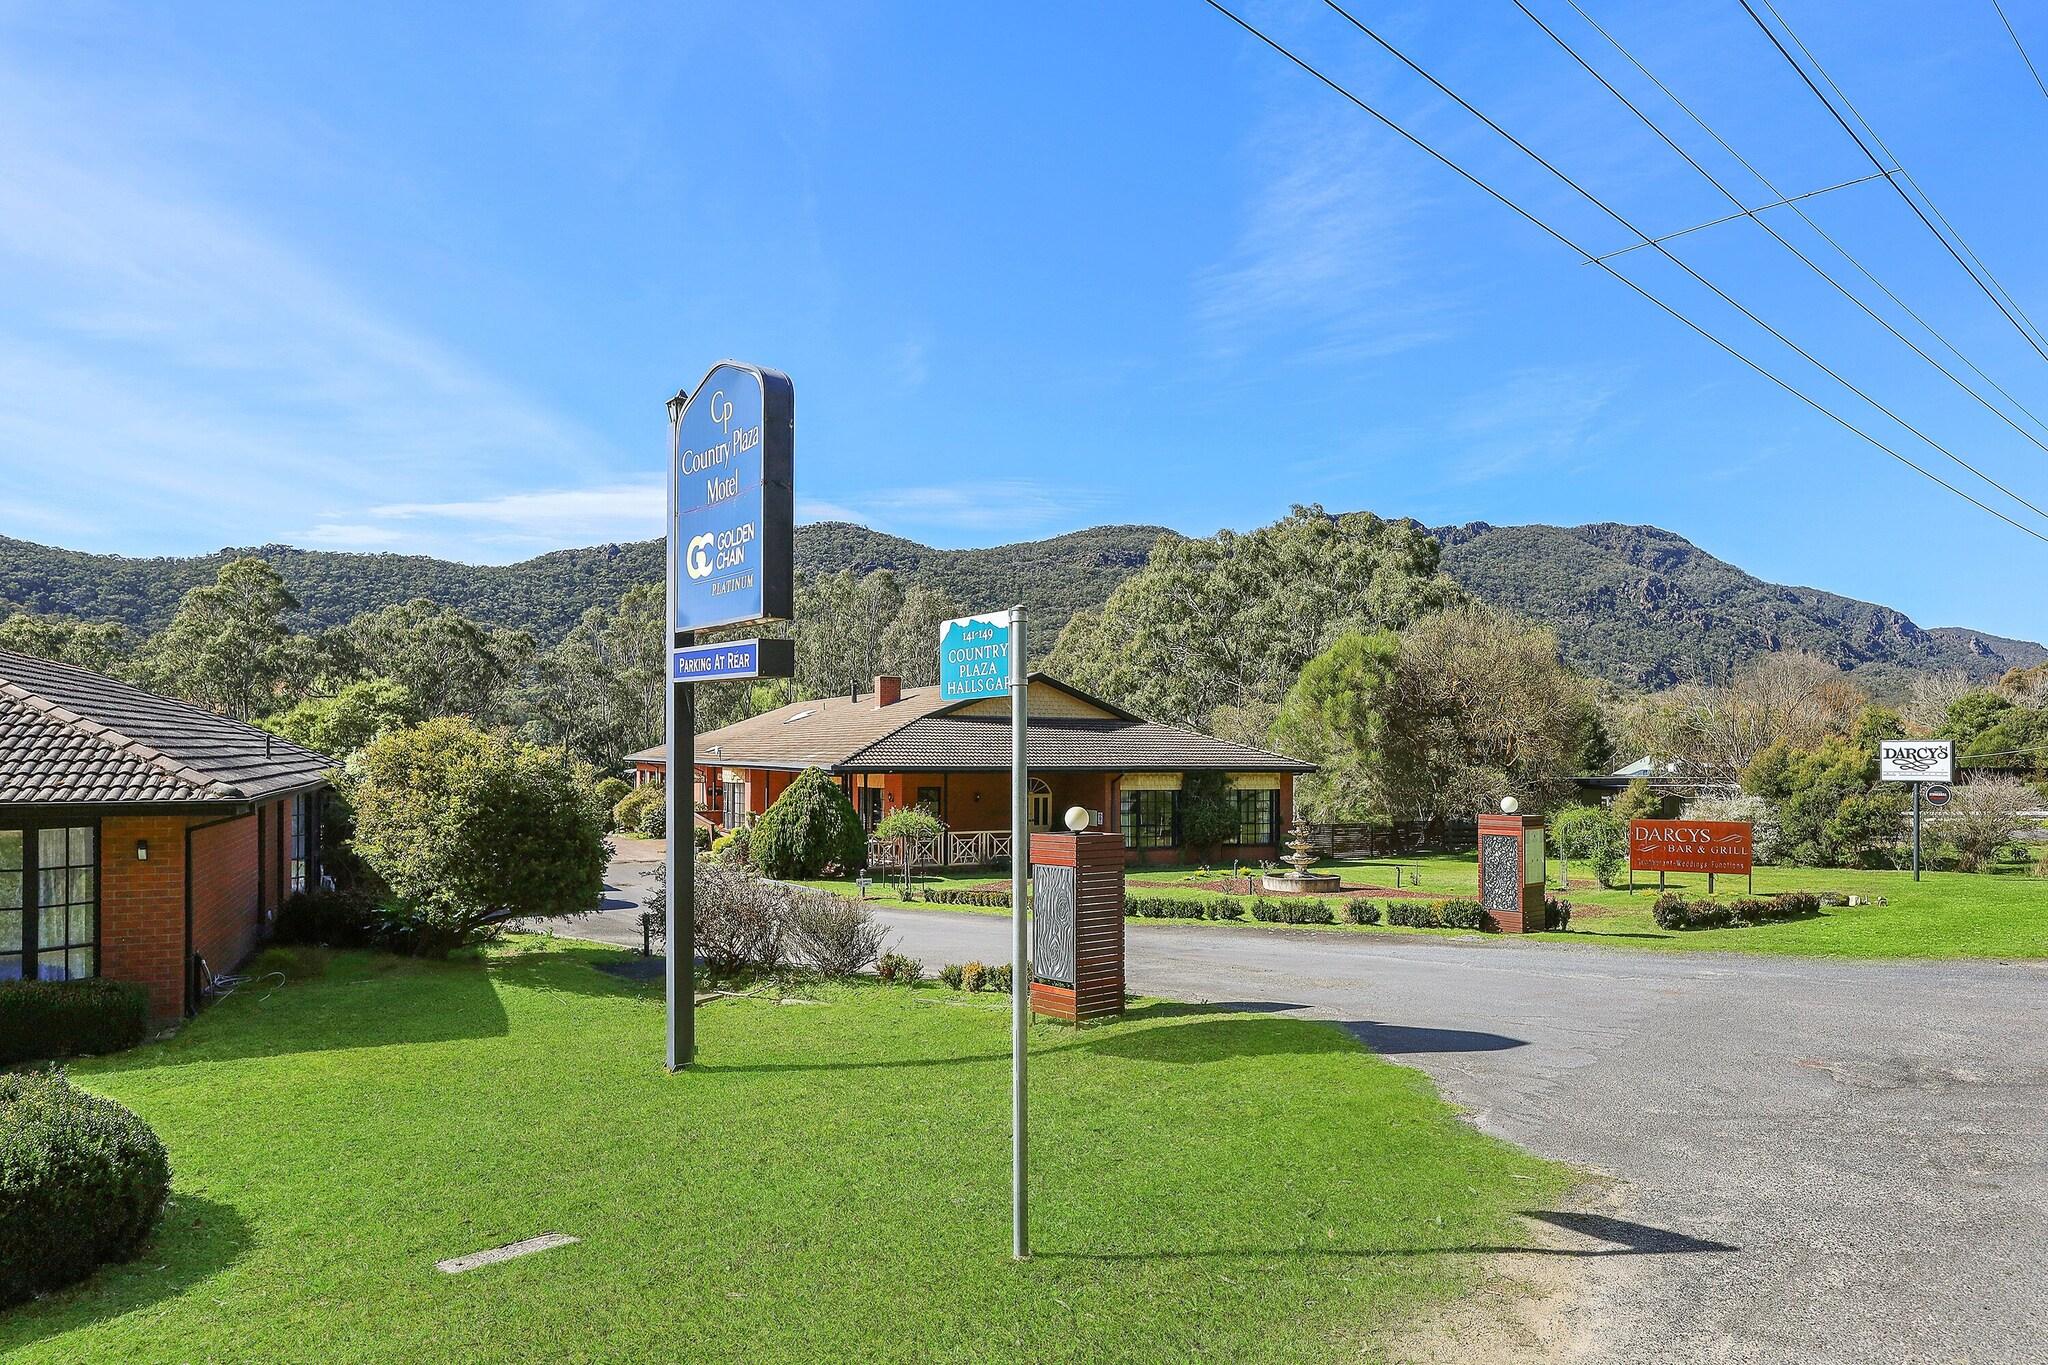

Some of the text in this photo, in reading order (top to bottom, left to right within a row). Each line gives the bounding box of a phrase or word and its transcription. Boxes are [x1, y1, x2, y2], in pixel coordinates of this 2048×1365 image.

[681, 426, 759, 475] Country Plaza
[707, 468, 738, 505] Motel
[717, 521, 755, 551] GOLDEN
[716, 545, 745, 570] CHAIN
[711, 574, 754, 596] PLATINUM
[679, 657, 711, 673] PARKING
[714, 653, 725, 671] AT
[948, 643, 1009, 663] COUNTRY
[959, 661, 997, 678] PLAZA
[947, 679, 984, 695] HALLS
[1883, 745, 1949, 761] DARCY'S
[1635, 826, 1711, 843] DARCYS
[1668, 844, 1749, 855] BAR & GRILL
